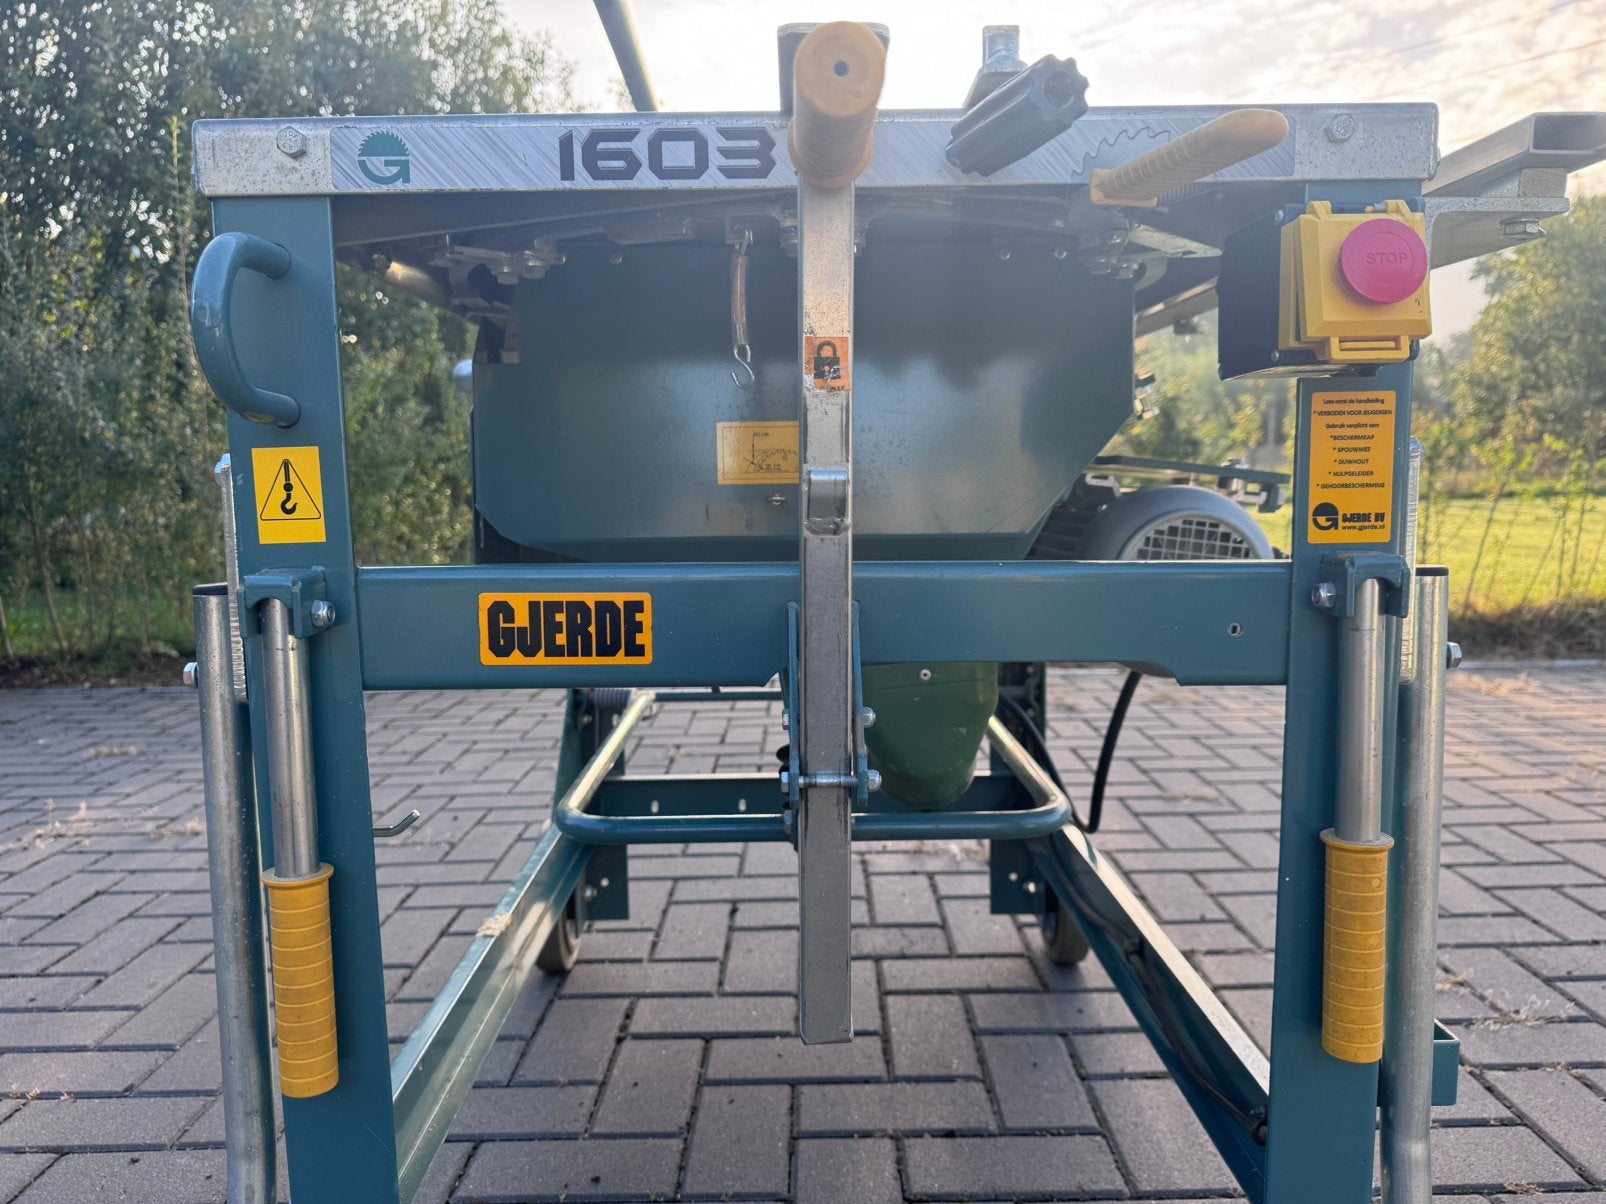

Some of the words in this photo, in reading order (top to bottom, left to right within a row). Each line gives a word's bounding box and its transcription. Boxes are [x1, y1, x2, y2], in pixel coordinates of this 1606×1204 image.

[558, 127, 777, 182] 1603
[1365, 252, 1408, 265] STOP
[1355, 397, 1385, 405] handleiding
[1342, 512, 1372, 523] GJERDE
[487, 600, 646, 658] GJERDE
